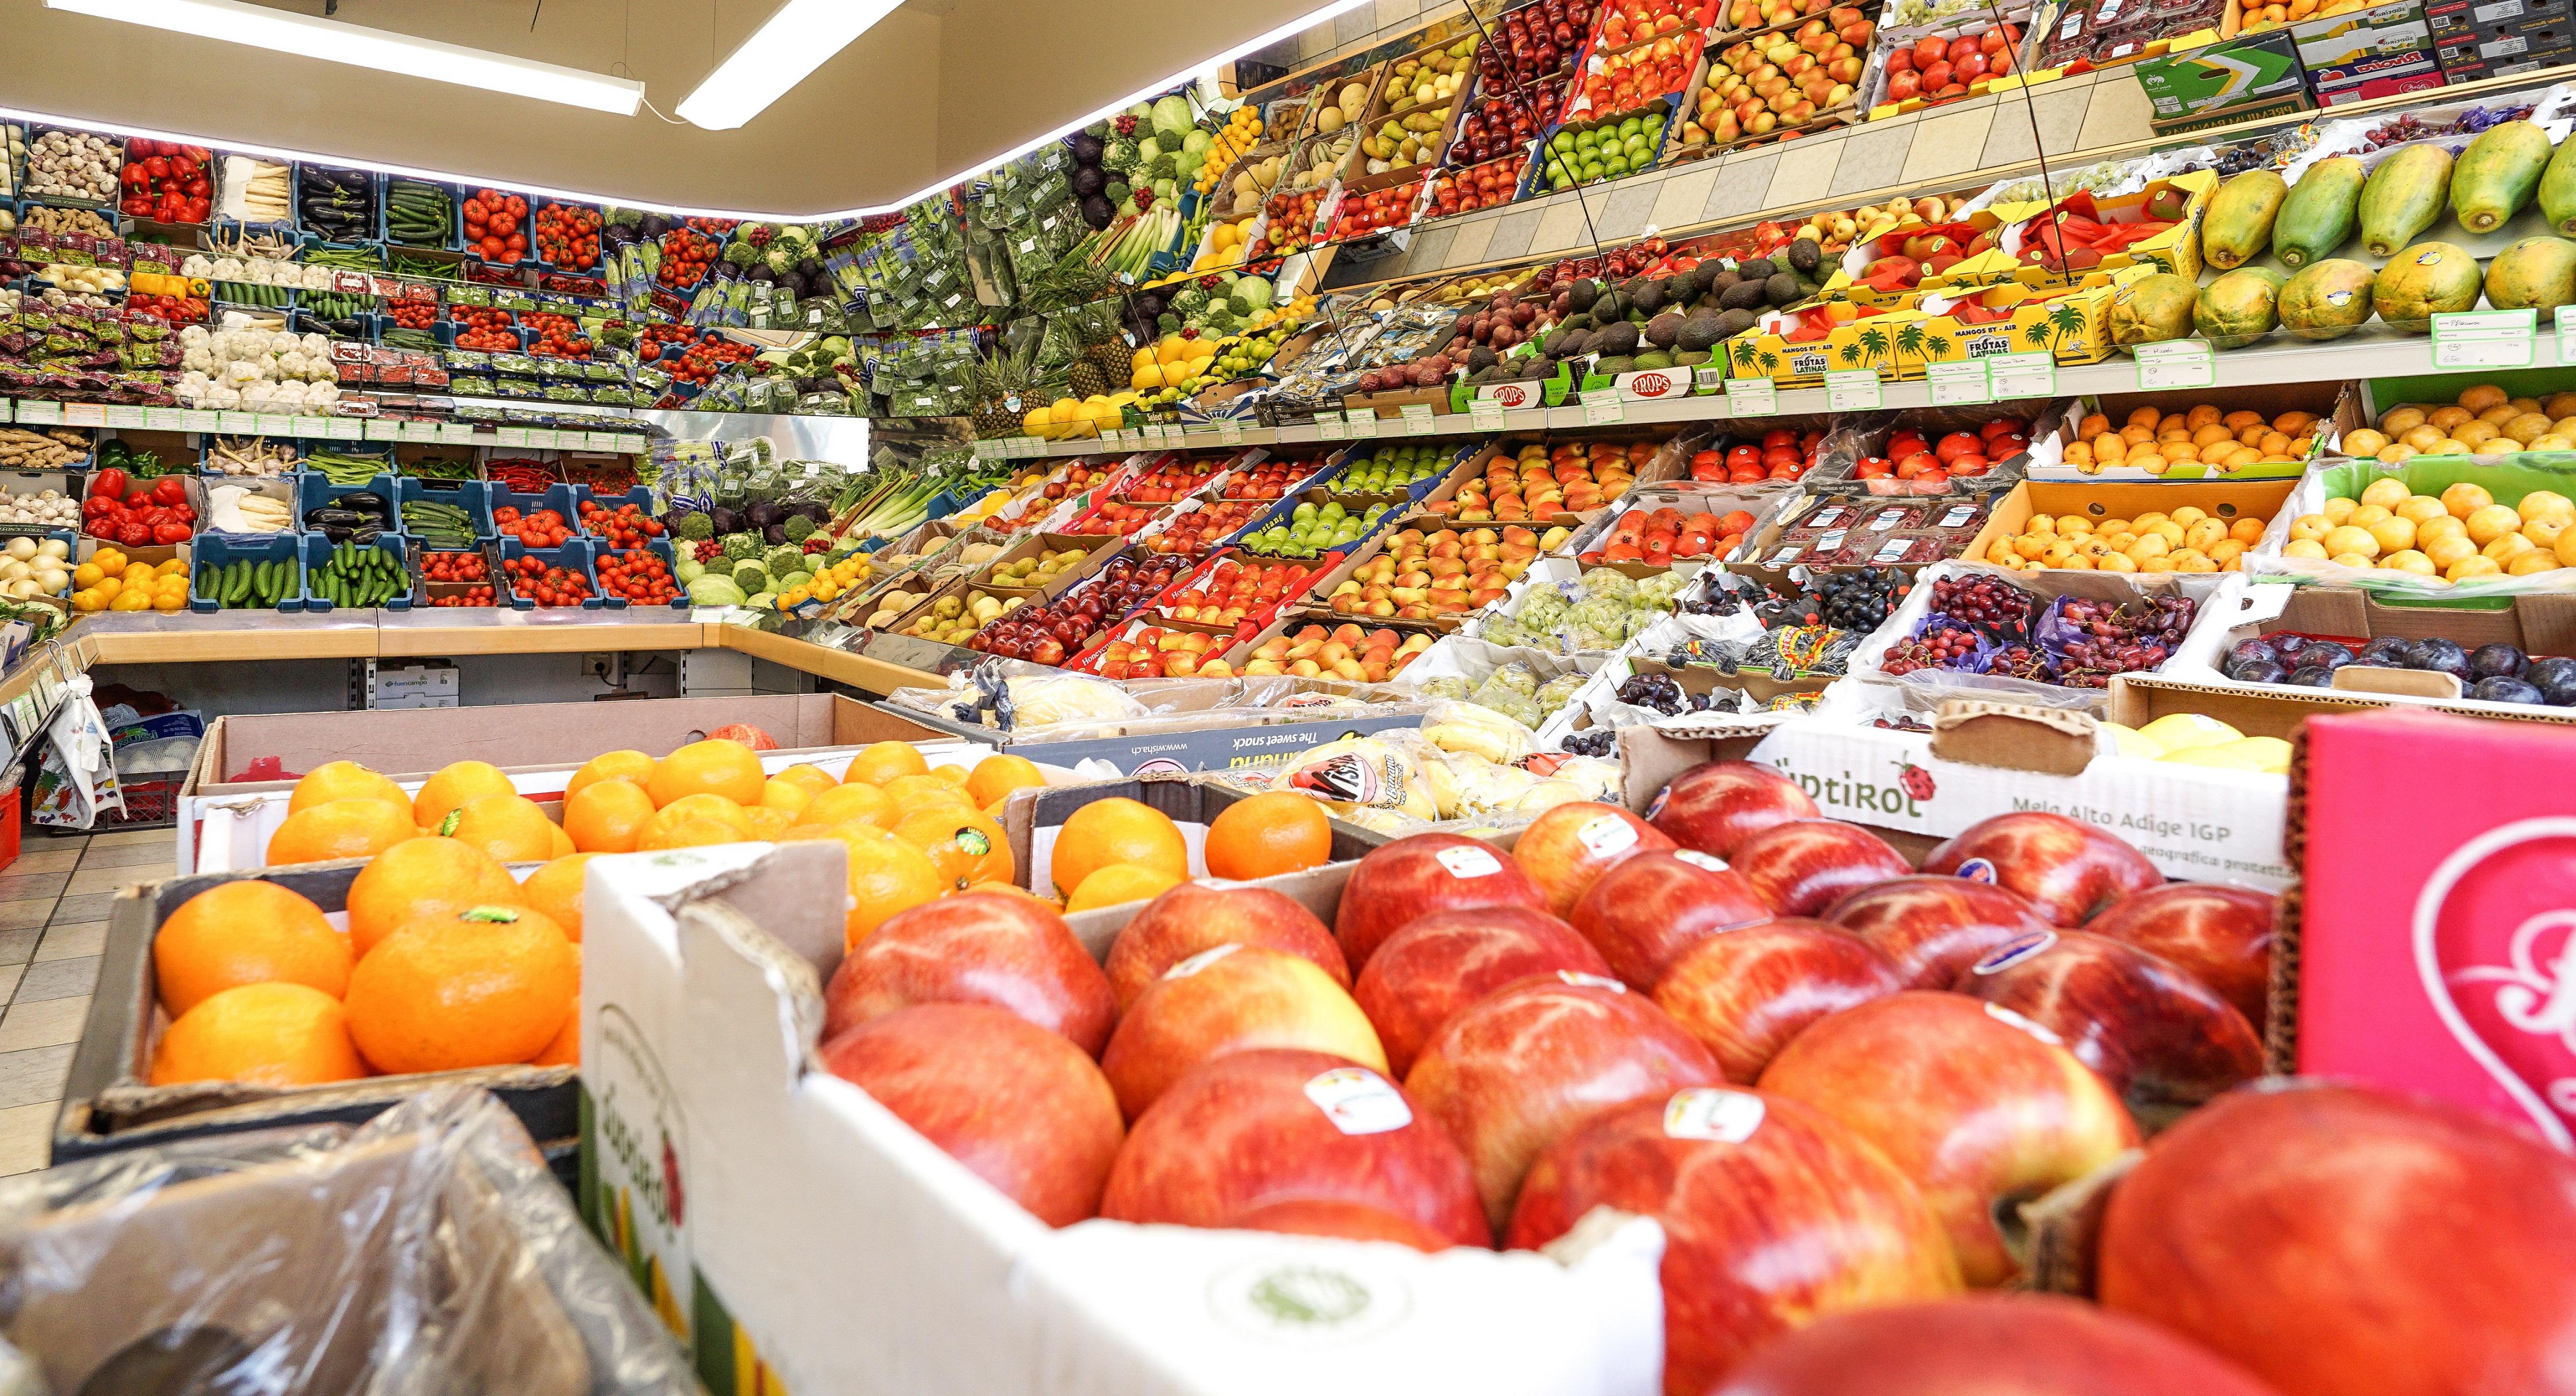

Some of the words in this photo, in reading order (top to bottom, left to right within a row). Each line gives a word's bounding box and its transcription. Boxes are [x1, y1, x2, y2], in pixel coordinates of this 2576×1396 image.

[1954, 328, 1986, 337] MANGOS
[1782, 346, 1808, 354] MANGOS
[1796, 365, 1827, 373] LATINAS
[1633, 374, 1671, 393] TROPS
[1494, 387, 1525, 404] TROPS
[1146, 412, 1163, 421] Select
[1171, 569, 1208, 601] Honeycrunch
[1082, 633, 1122, 667] Honeycrunch
[1233, 735, 1265, 748] snack
[1266, 733, 1298, 746] sweet
[1299, 732, 1317, 743] The
[1131, 743, 1188, 756] www.wisha.ch
[1384, 754, 1397, 800] Banana
[2069, 805, 2113, 825] Alto
[2120, 812, 2182, 837] Adige
[2189, 822, 2231, 843] IGP
